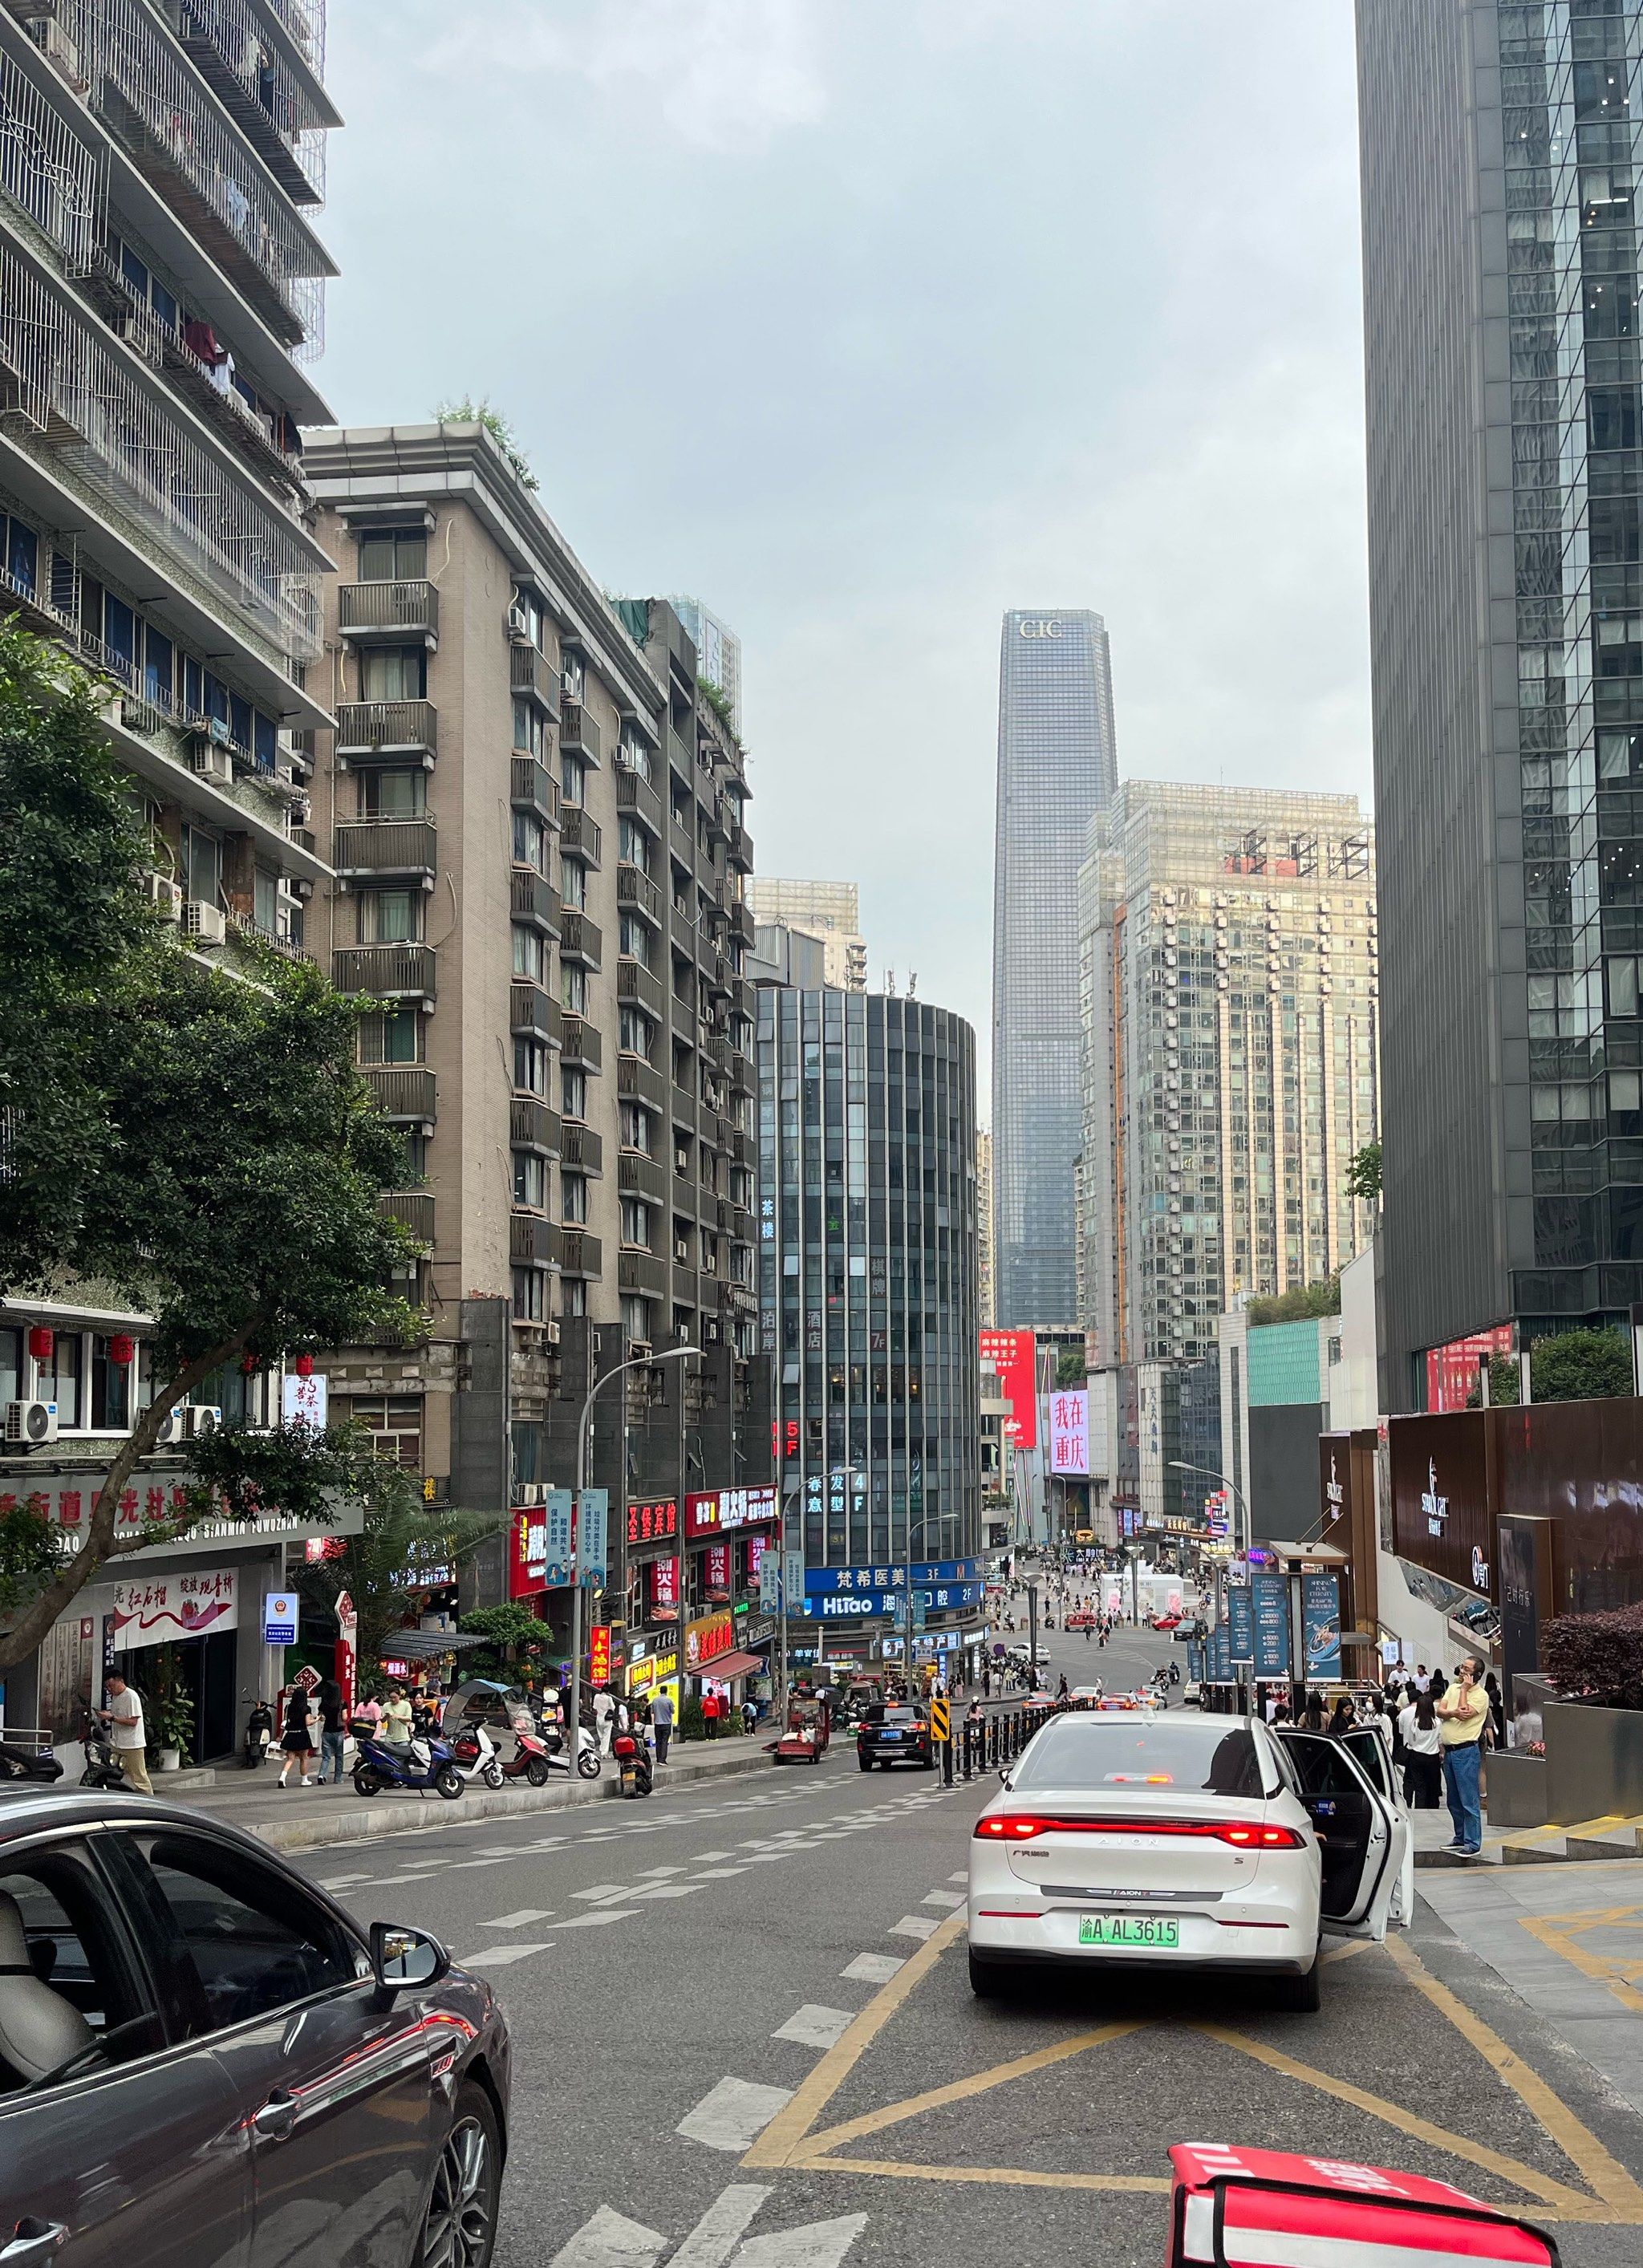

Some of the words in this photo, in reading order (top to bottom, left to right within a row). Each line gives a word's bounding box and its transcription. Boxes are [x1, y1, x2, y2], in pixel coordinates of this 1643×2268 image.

[1020, 619, 1062, 639] CIC
[762, 1199, 774, 1239] 茶楼
[871, 1258, 886, 1295] 棋牌
[807, 1311, 821, 1348] 酒店
[871, 1333, 886, 1349] 7F
[1055, 1396, 1083, 1430] 我在
[1056, 1435, 1085, 1469] 重庆
[830, 1475, 844, 1511] 发型
[629, 1503, 675, 1540] 圣堡宾馆
[657, 1560, 672, 1601] 潮火锅
[711, 1547, 724, 1584] 潮火锅
[837, 1568, 905, 1588] 梵希医美
[927, 1568, 939, 1580] 3F
[823, 1597, 873, 1615] HiTao
[882, 1590, 948, 1612] 海口腔
[963, 1588, 972, 1601] 2F
[1098, 1837, 1158, 1846] AION
[1234, 1856, 1244, 1865] S
[1112, 1919, 1176, 1942] AL3615
